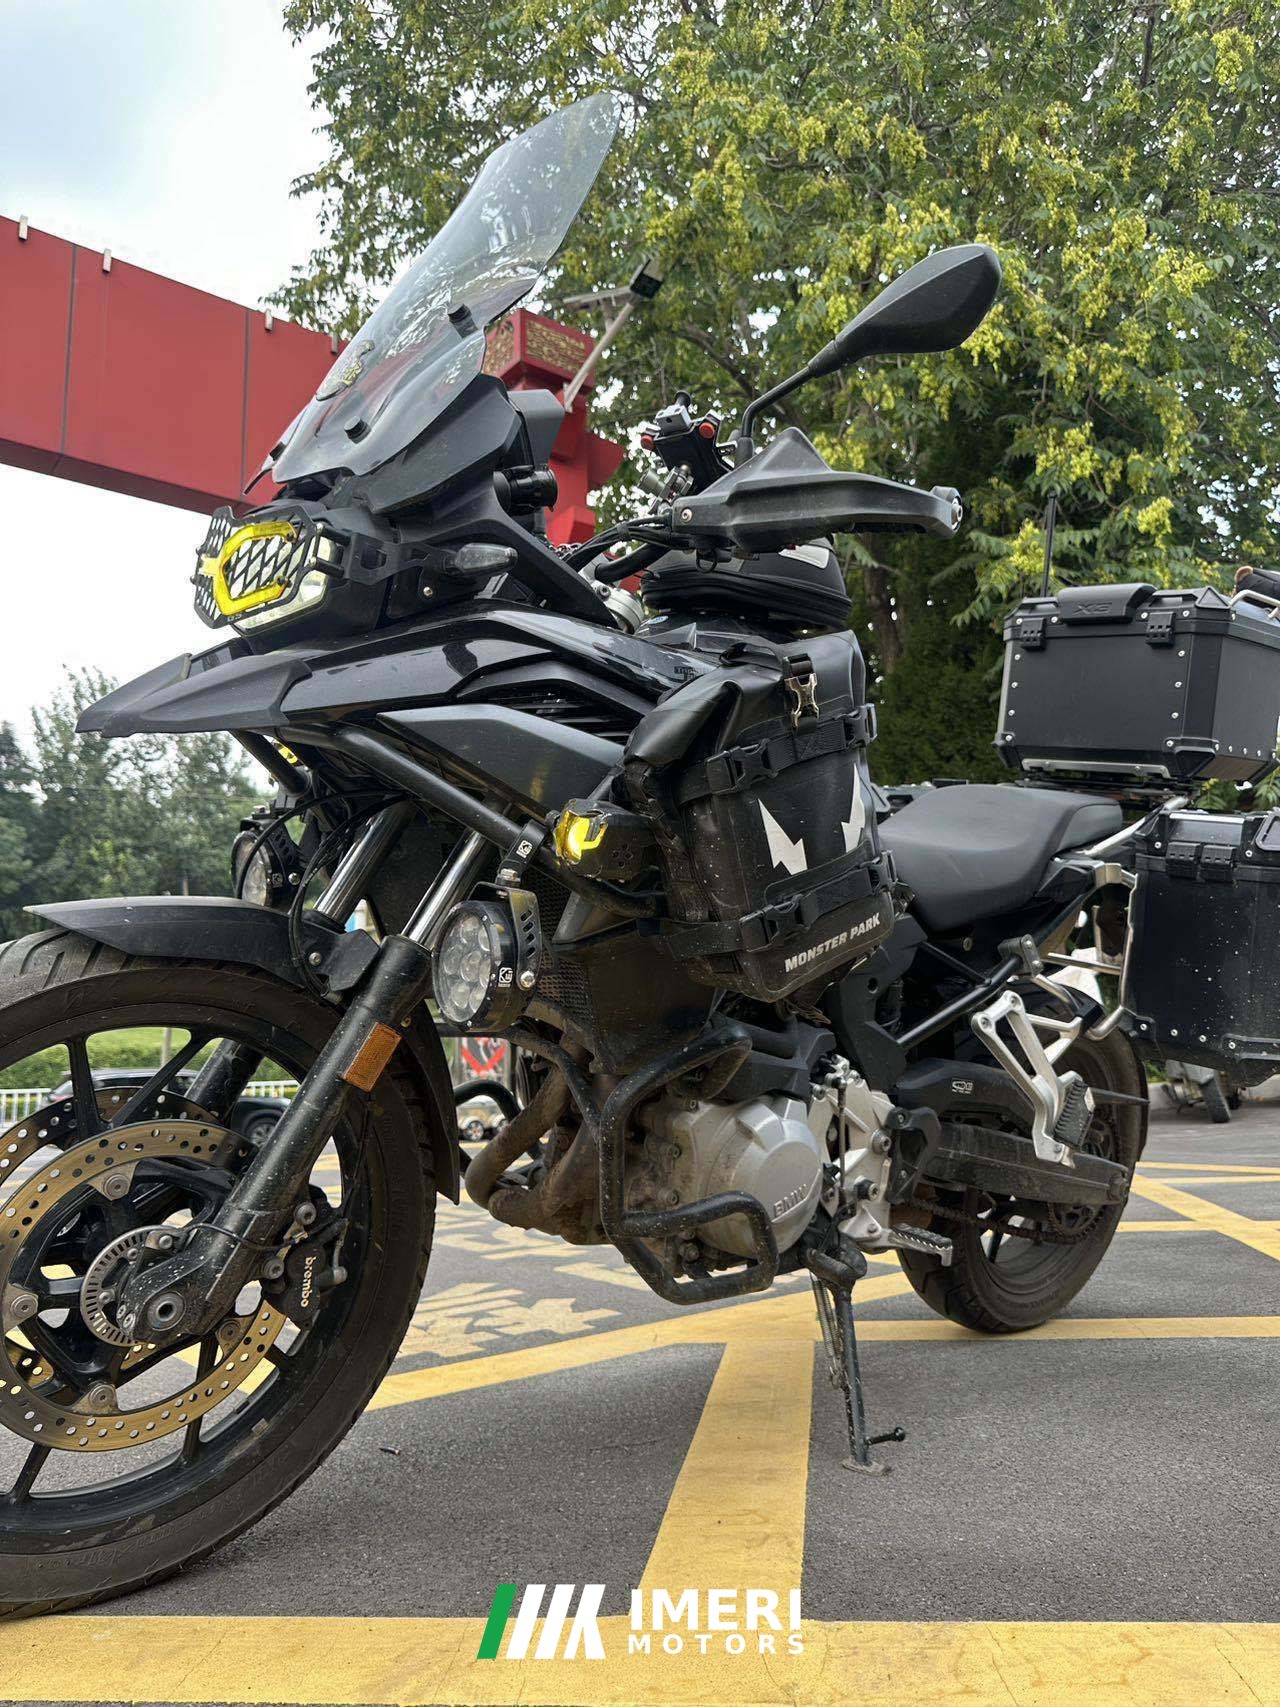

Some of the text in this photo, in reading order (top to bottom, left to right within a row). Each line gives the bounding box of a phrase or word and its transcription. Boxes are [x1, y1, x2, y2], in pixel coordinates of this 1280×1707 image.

[784, 912, 880, 973] MONSTER PARK
[300, 1256, 317, 1308] brembo
